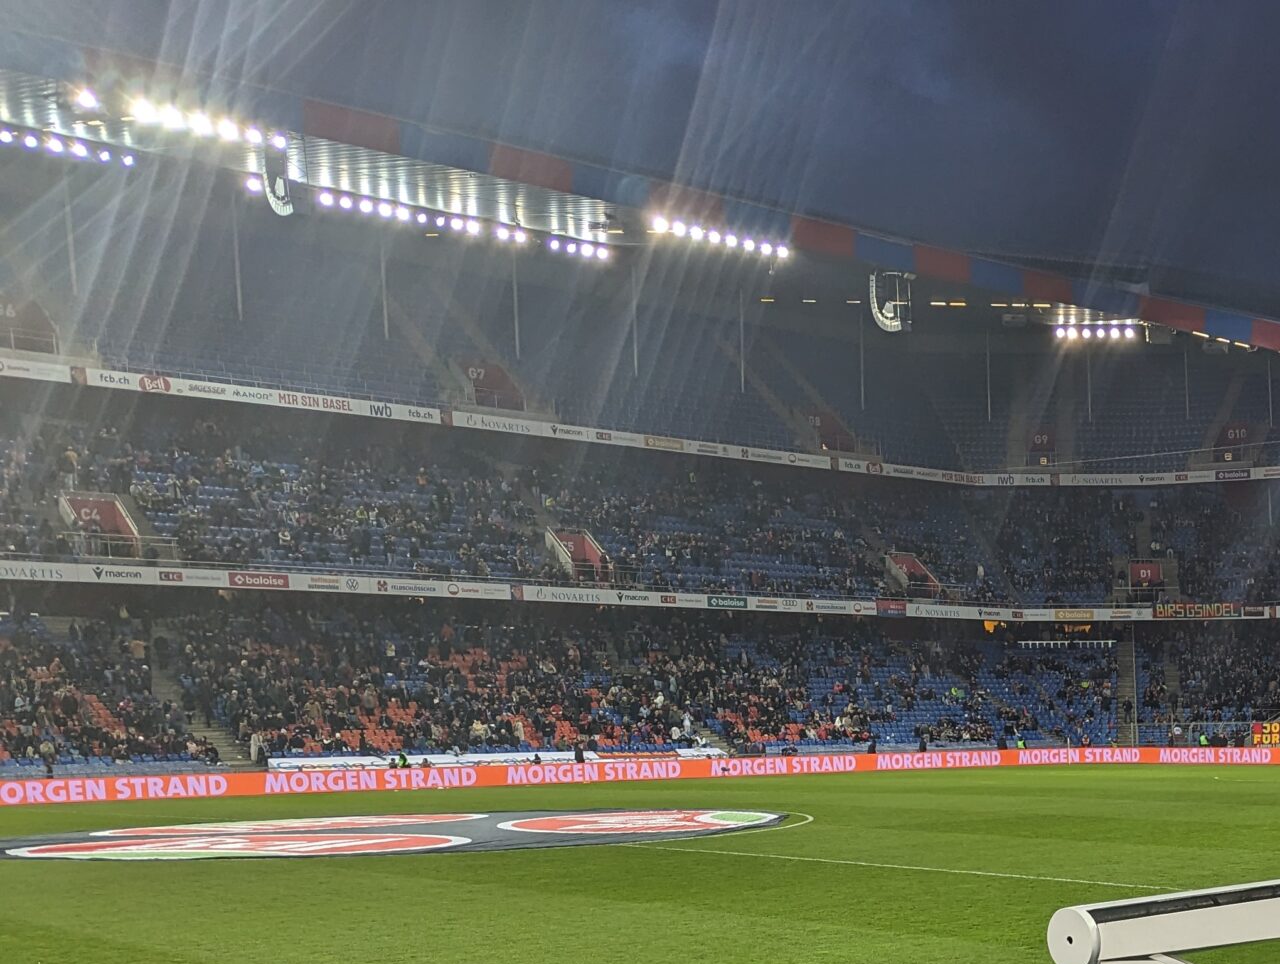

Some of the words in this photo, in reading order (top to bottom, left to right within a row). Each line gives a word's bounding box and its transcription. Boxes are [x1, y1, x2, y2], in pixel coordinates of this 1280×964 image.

[100, 373, 130, 386] fcb.ch
[144, 376, 166, 391] Bell
[278, 392, 299, 406] MIR
[302, 396, 320, 408] SIN
[322, 398, 353, 412] BASEL
[408, 408, 433, 420] fcb.ch
[481, 415, 531, 433] NOVARTIS
[105, 570, 142, 579] macron
[160, 572, 183, 581] CIC
[245, 575, 284, 587] baloise
[551, 591, 600, 602] NOVARTIS
[718, 597, 745, 607] baloise
[925, 608, 960, 618] NOVARTIS
[878, 753, 941, 768] MORGEN
[946, 751, 1001, 767] STRAND
[1020, 749, 1079, 763] MORGEN
[1085, 749, 1139, 762] STRAND
[1160, 748, 1214, 762] MORGEN
[1219, 749, 1270, 762] STRAND
[507, 763, 598, 784] MORGEN
[605, 761, 681, 780] STRAND
[711, 757, 787, 776] MORGEN
[792, 756, 855, 772] STRAND
[265, 771, 377, 792] MORGEN
[384, 767, 477, 789] STRAND
[116, 776, 227, 799] STRAND
